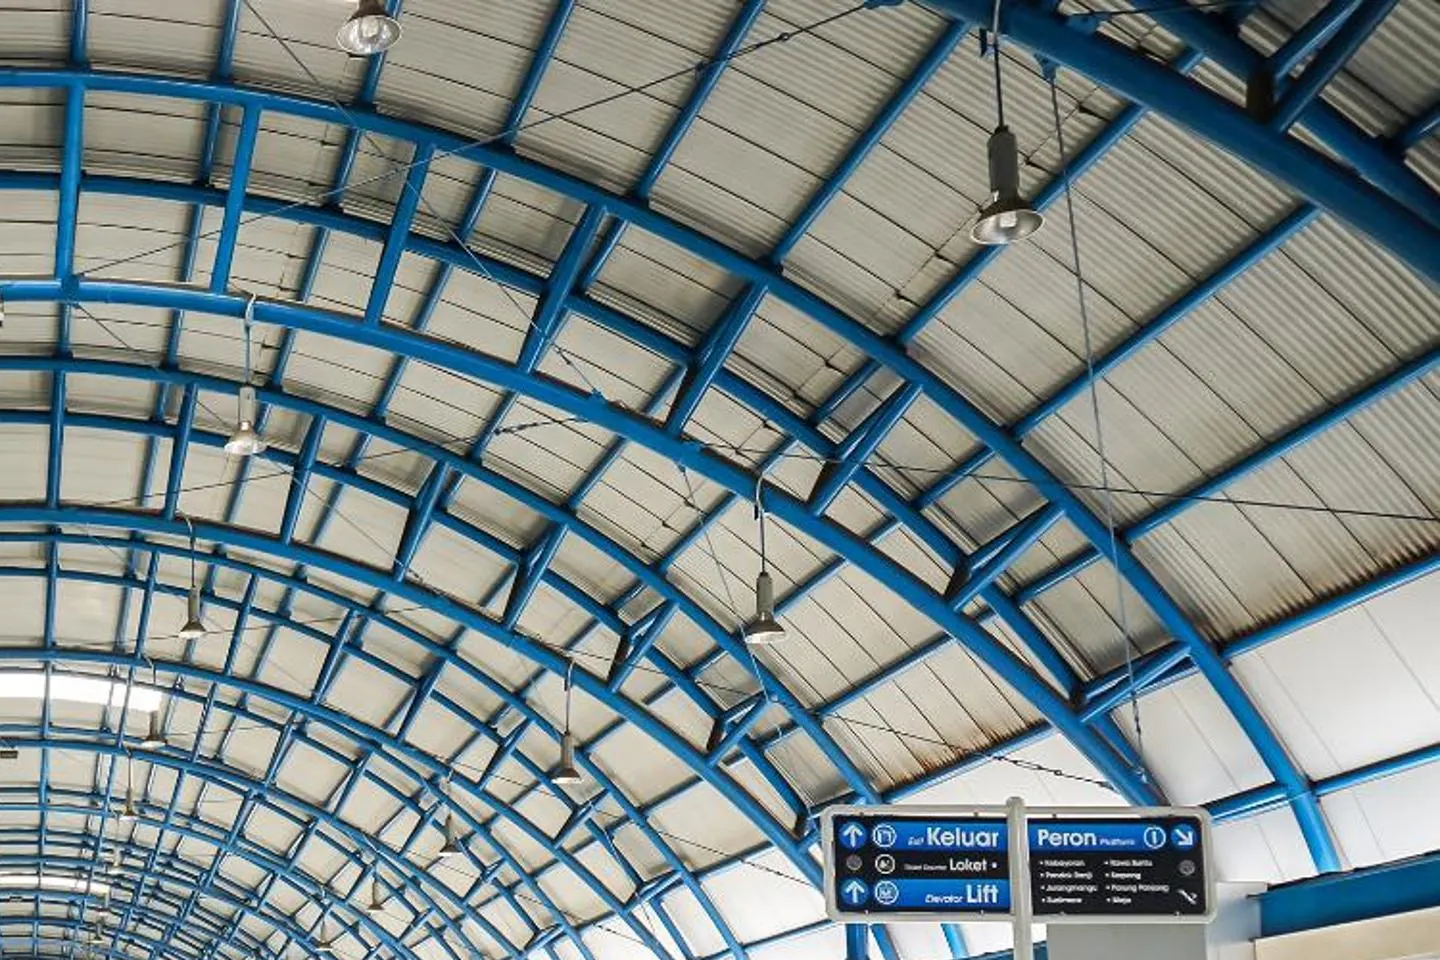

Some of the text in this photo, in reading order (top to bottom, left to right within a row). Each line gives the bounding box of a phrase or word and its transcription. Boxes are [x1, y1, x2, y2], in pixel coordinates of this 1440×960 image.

[926, 827, 999, 848] Keluar
[1037, 829, 1097, 846] Peron
[949, 858, 988, 871] Loket
[924, 884, 999, 904] Elevator Lift
